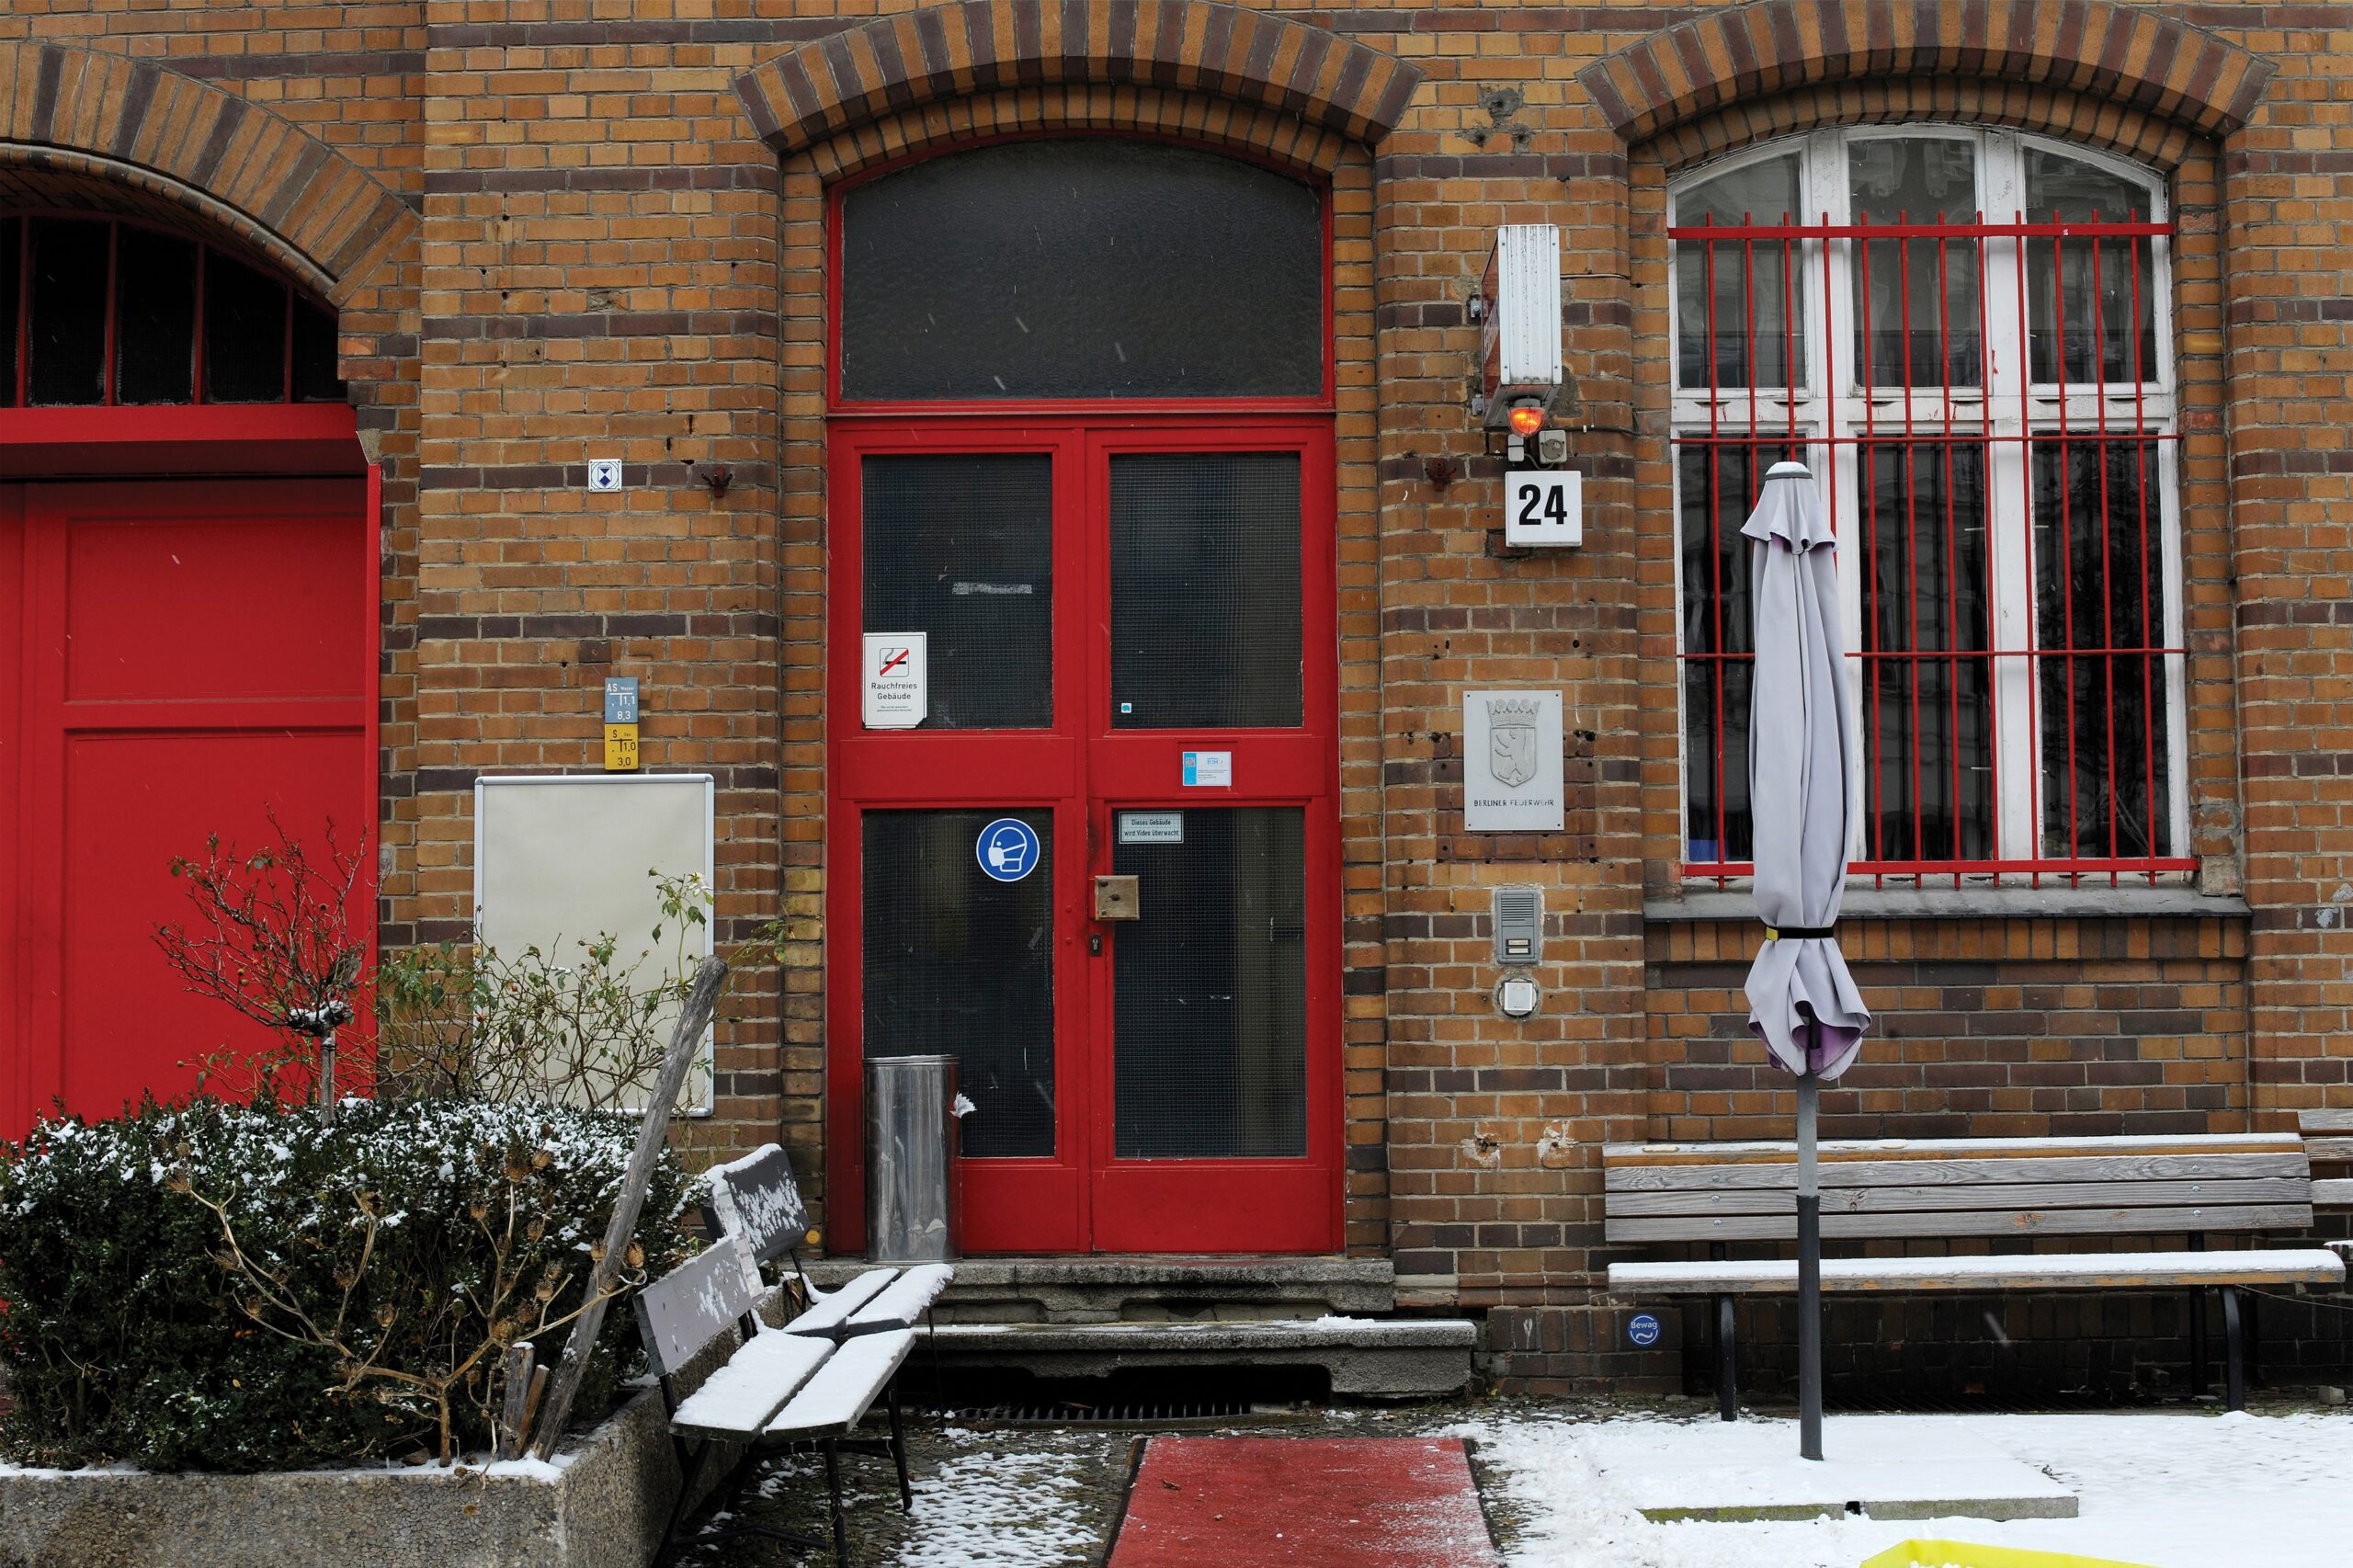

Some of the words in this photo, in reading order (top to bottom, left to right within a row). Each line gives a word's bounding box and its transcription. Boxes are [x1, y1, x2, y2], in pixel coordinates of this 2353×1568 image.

[1518, 483, 1568, 526] 24
[607, 683, 618, 692] AS
[870, 682, 917, 690] Rauchfreies
[877, 692, 911, 700] Gebäude
[612, 729, 618, 739] S
[1473, 799, 1507, 807] BERLINER
[1631, 1321, 1658, 1330] Bewag
